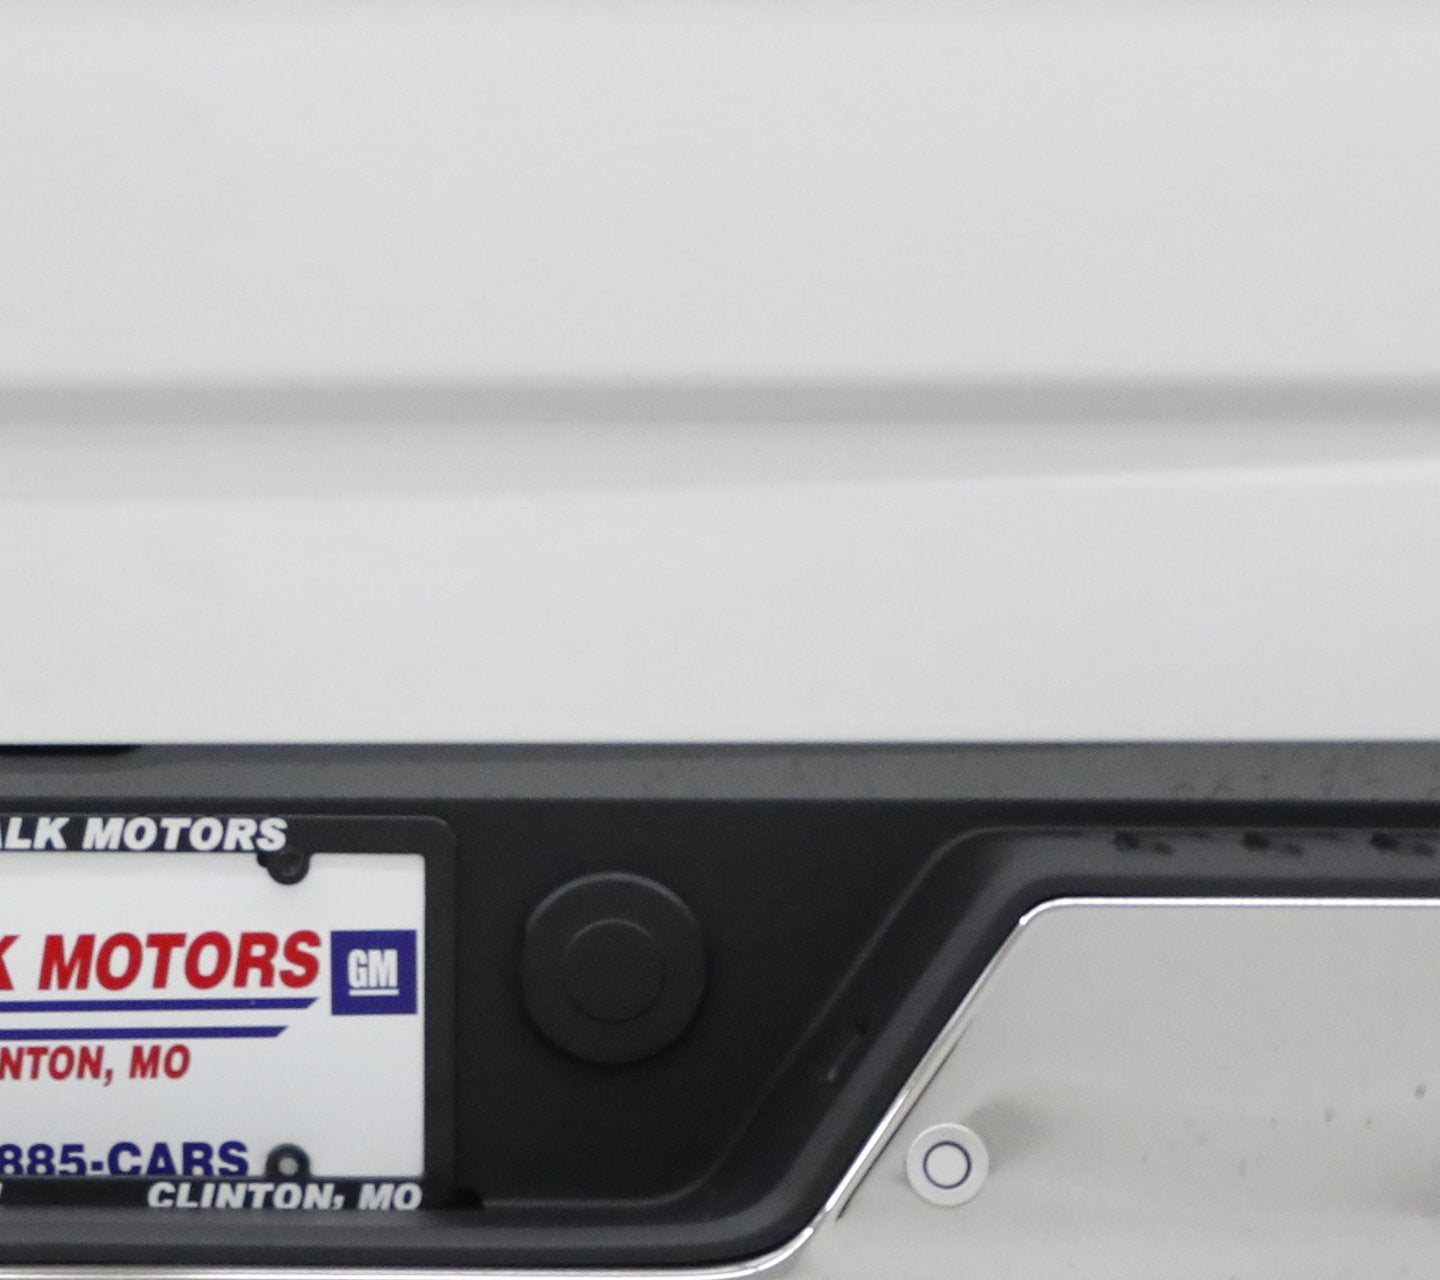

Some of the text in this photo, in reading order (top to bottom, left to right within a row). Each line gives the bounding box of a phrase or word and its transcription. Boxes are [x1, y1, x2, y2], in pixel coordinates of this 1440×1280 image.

[82, 817, 288, 852] MOTORS
[38, 930, 322, 991] MOTORS
[128, 1043, 192, 1079] MO
[146, 1182, 423, 1211] CLINTON, MO
